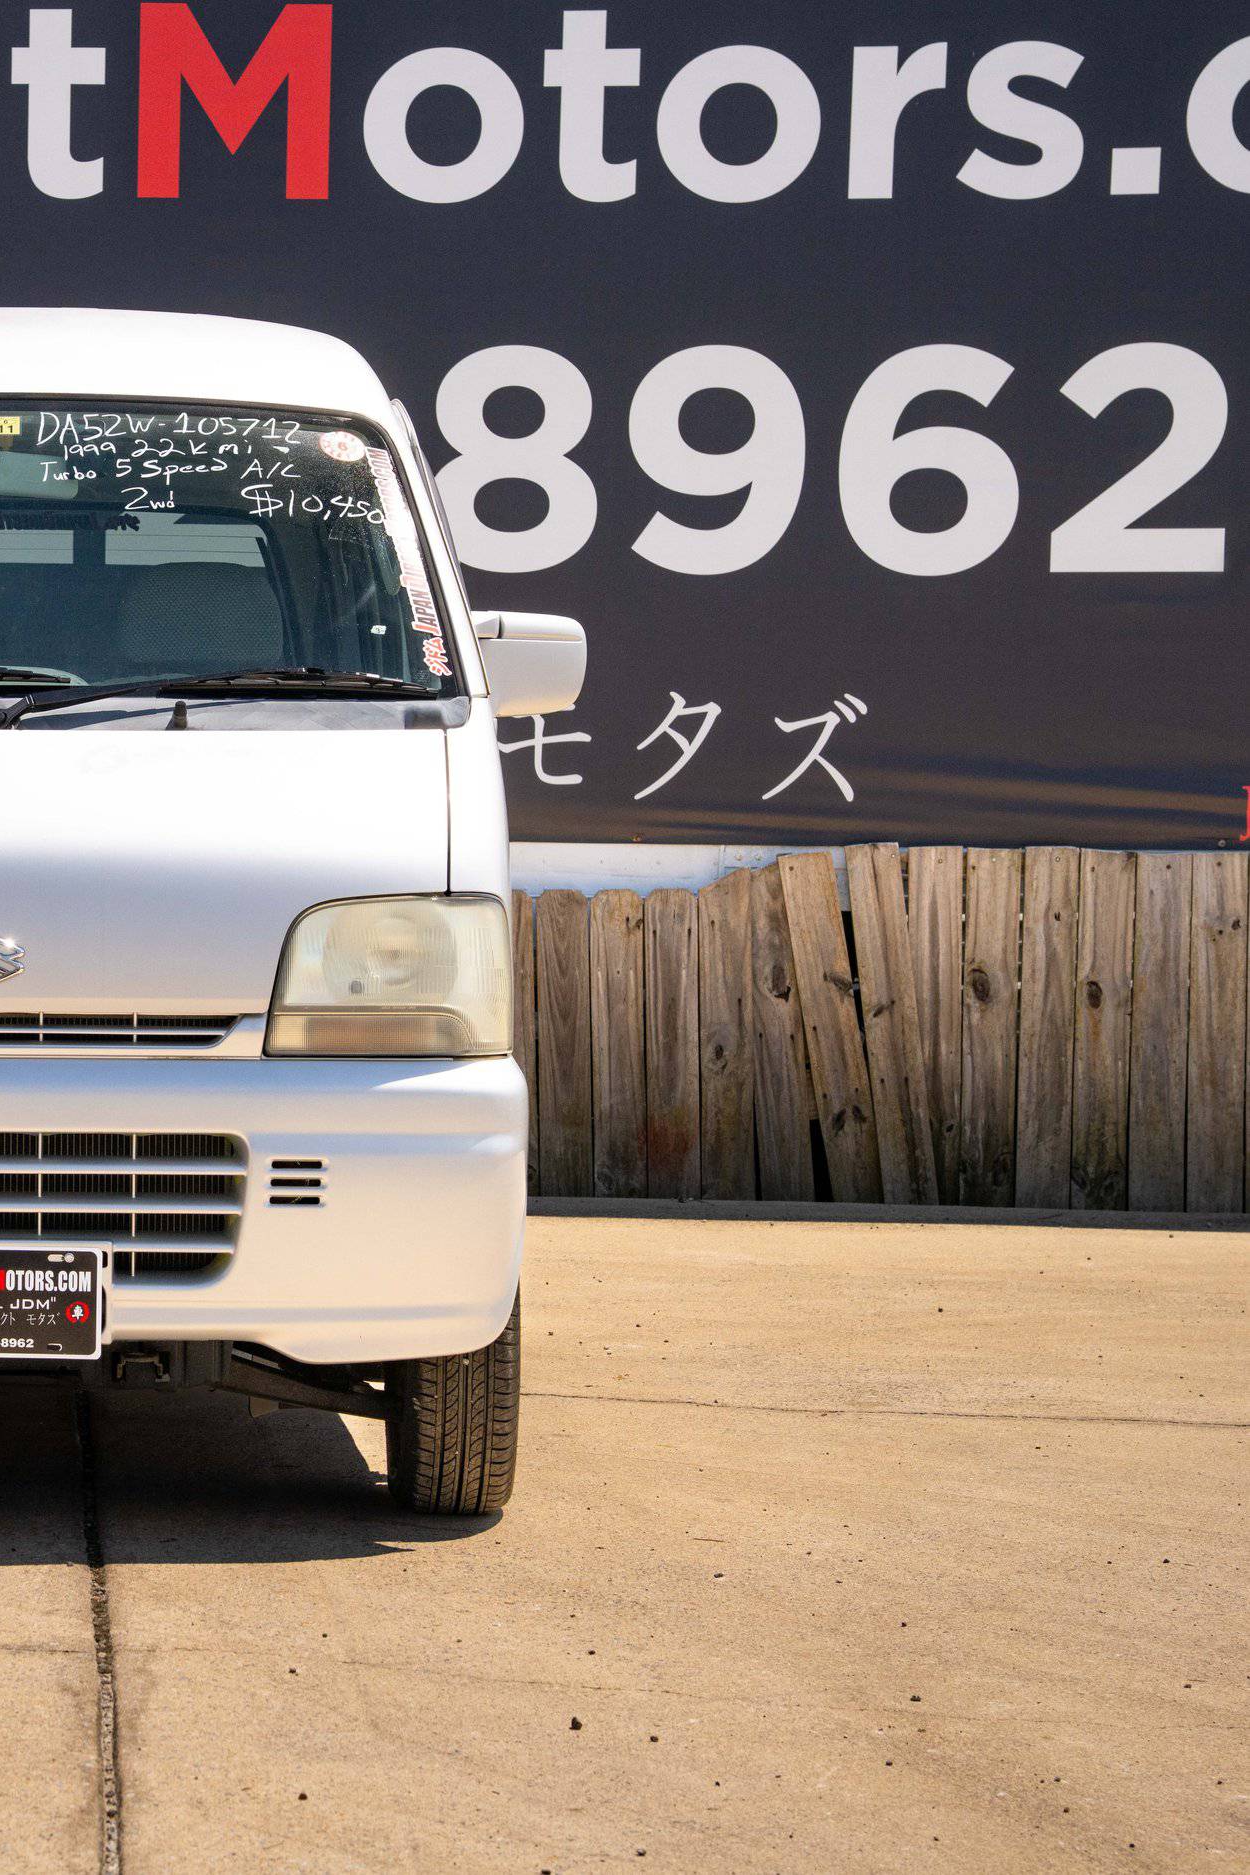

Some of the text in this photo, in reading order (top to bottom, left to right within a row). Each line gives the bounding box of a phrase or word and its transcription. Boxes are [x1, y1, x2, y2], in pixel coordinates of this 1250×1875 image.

[64, 441, 117, 460] 1999
[435, 342, 1229, 577] 8962
[40, 459, 301, 485] Turbo 5 Speed A/C
[241, 484, 384, 524] $10,450
